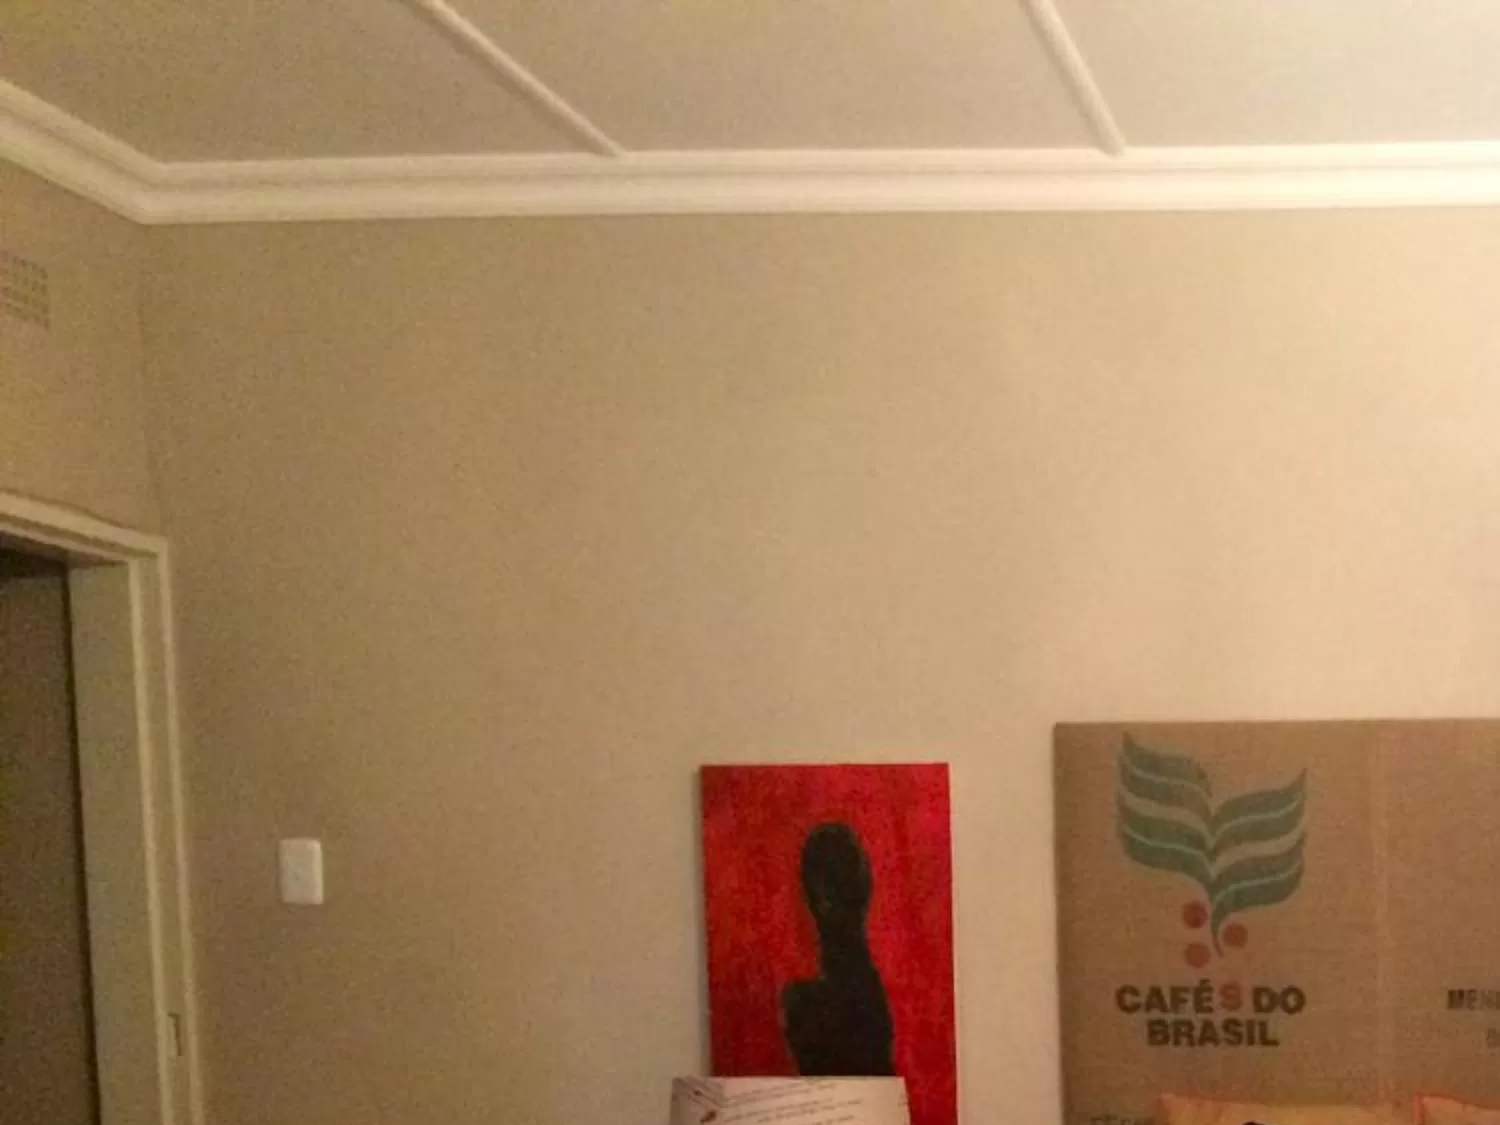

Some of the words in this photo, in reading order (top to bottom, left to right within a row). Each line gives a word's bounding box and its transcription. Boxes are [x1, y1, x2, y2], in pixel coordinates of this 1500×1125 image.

[1116, 978, 1244, 1014] CAFÉS
[1252, 984, 1306, 1015] DO
[1146, 1018, 1280, 1047] BRASIL
